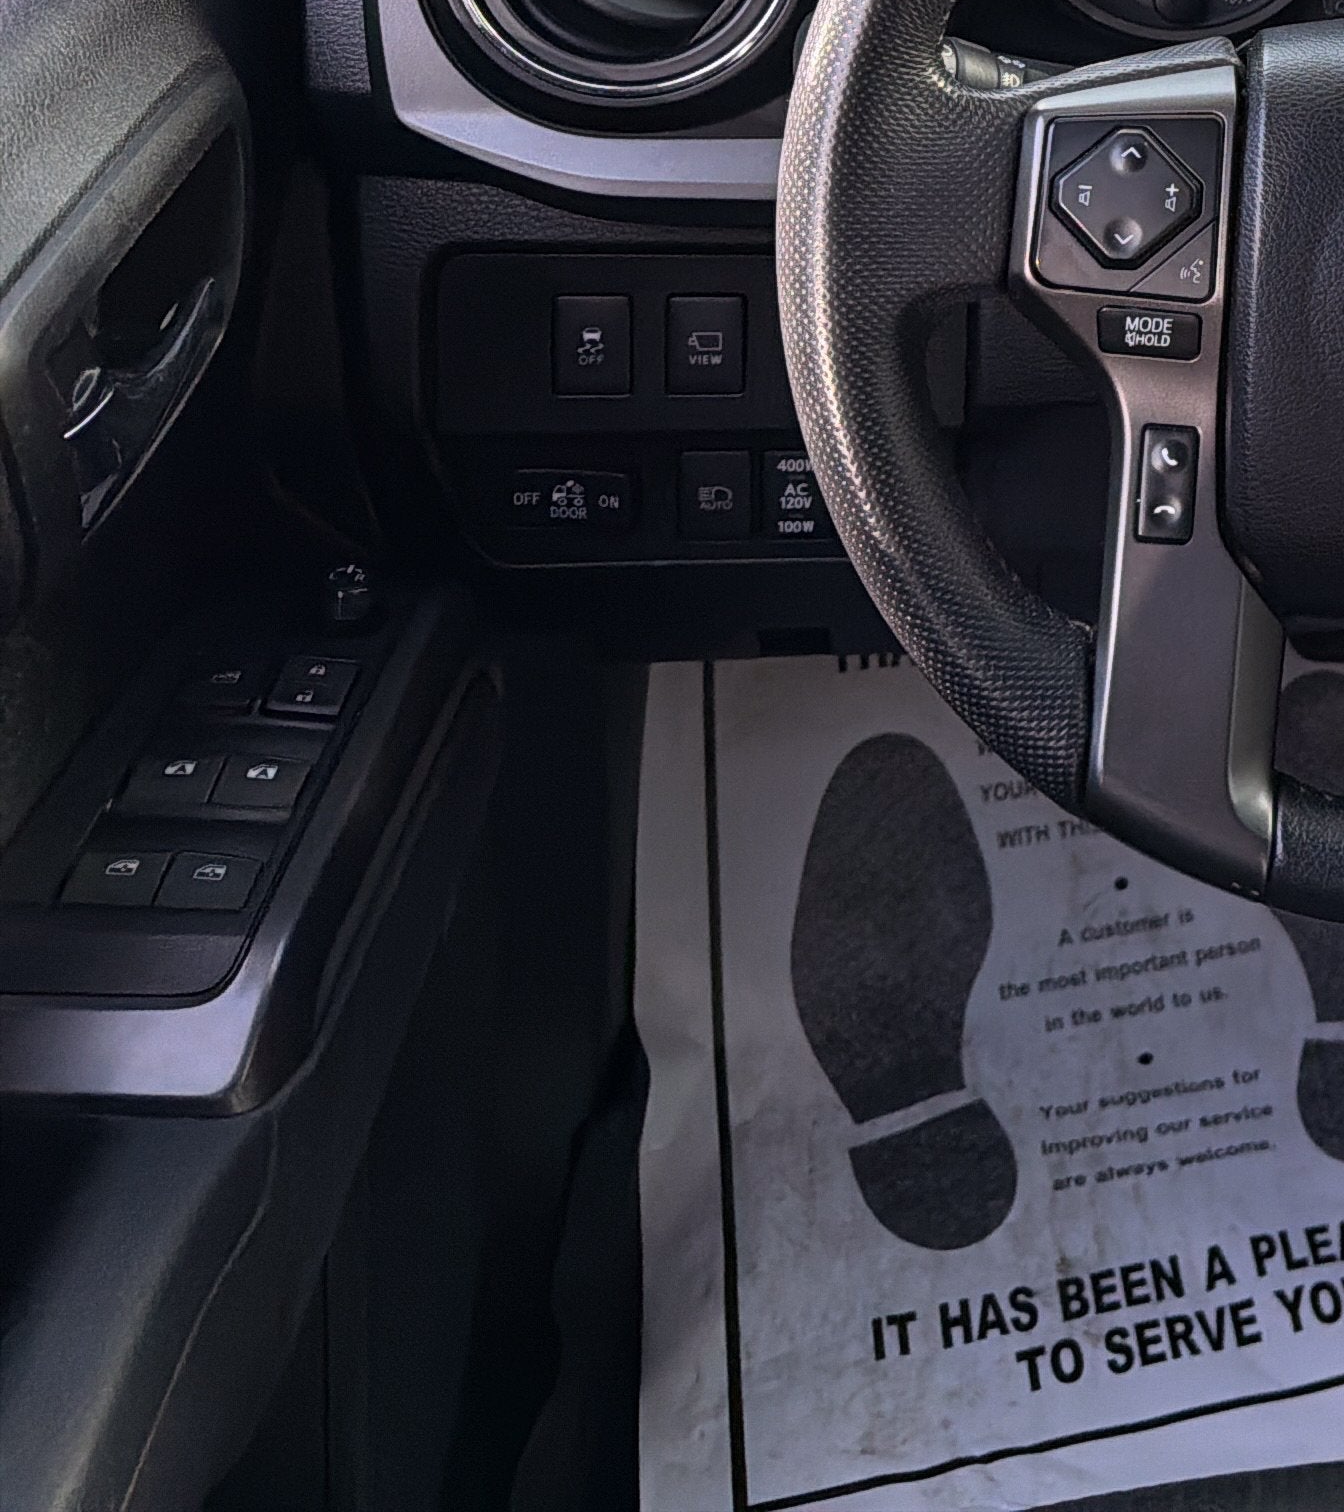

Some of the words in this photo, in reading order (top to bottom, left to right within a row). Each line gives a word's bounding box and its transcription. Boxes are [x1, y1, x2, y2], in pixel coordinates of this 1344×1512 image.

[1124, 316, 1173, 334] MODE
[1135, 332, 1171, 347] HOLD
[577, 354, 605, 366] OFF
[688, 354, 723, 366] VIEW
[784, 483, 809, 496] AC
[513, 492, 541, 506] OFF
[598, 495, 620, 509] ON
[699, 500, 733, 511] AUTO
[778, 497, 813, 510] 120V
[550, 507, 588, 520] DOOR
[777, 521, 815, 534] 100W
[998, 824, 1051, 849] WITH
[1057, 928, 1074, 947] A
[1080, 912, 1170, 943] customer
[1178, 908, 1195, 925] is
[999, 980, 1030, 1001] the
[1038, 969, 1087, 993] most
[1094, 950, 1188, 981] important
[1194, 937, 1262, 967] person
[1044, 1016, 1064, 1032] in
[1071, 1007, 1102, 1027] the
[1110, 994, 1166, 1020] world
[1172, 991, 1193, 1008] to
[1200, 986, 1228, 1004] us.
[1039, 1099, 1089, 1121] Your
[1098, 1073, 1226, 1109] suggestions
[1232, 1068, 1261, 1086] for
[1154, 1118, 1191, 1137] our
[1199, 1103, 1273, 1129] service
[1052, 1172, 1087, 1191] are
[1094, 1158, 1170, 1184] always
[1178, 1138, 1276, 1167] welcome.
[872, 1311, 917, 1361] IT
[939, 1287, 1039, 1350] HAS
[1057, 1254, 1186, 1322] BEEN
[1206, 1245, 1237, 1292] A
[1016, 1338, 1085, 1391] TO
[1105, 1300, 1262, 1374] SERVE
